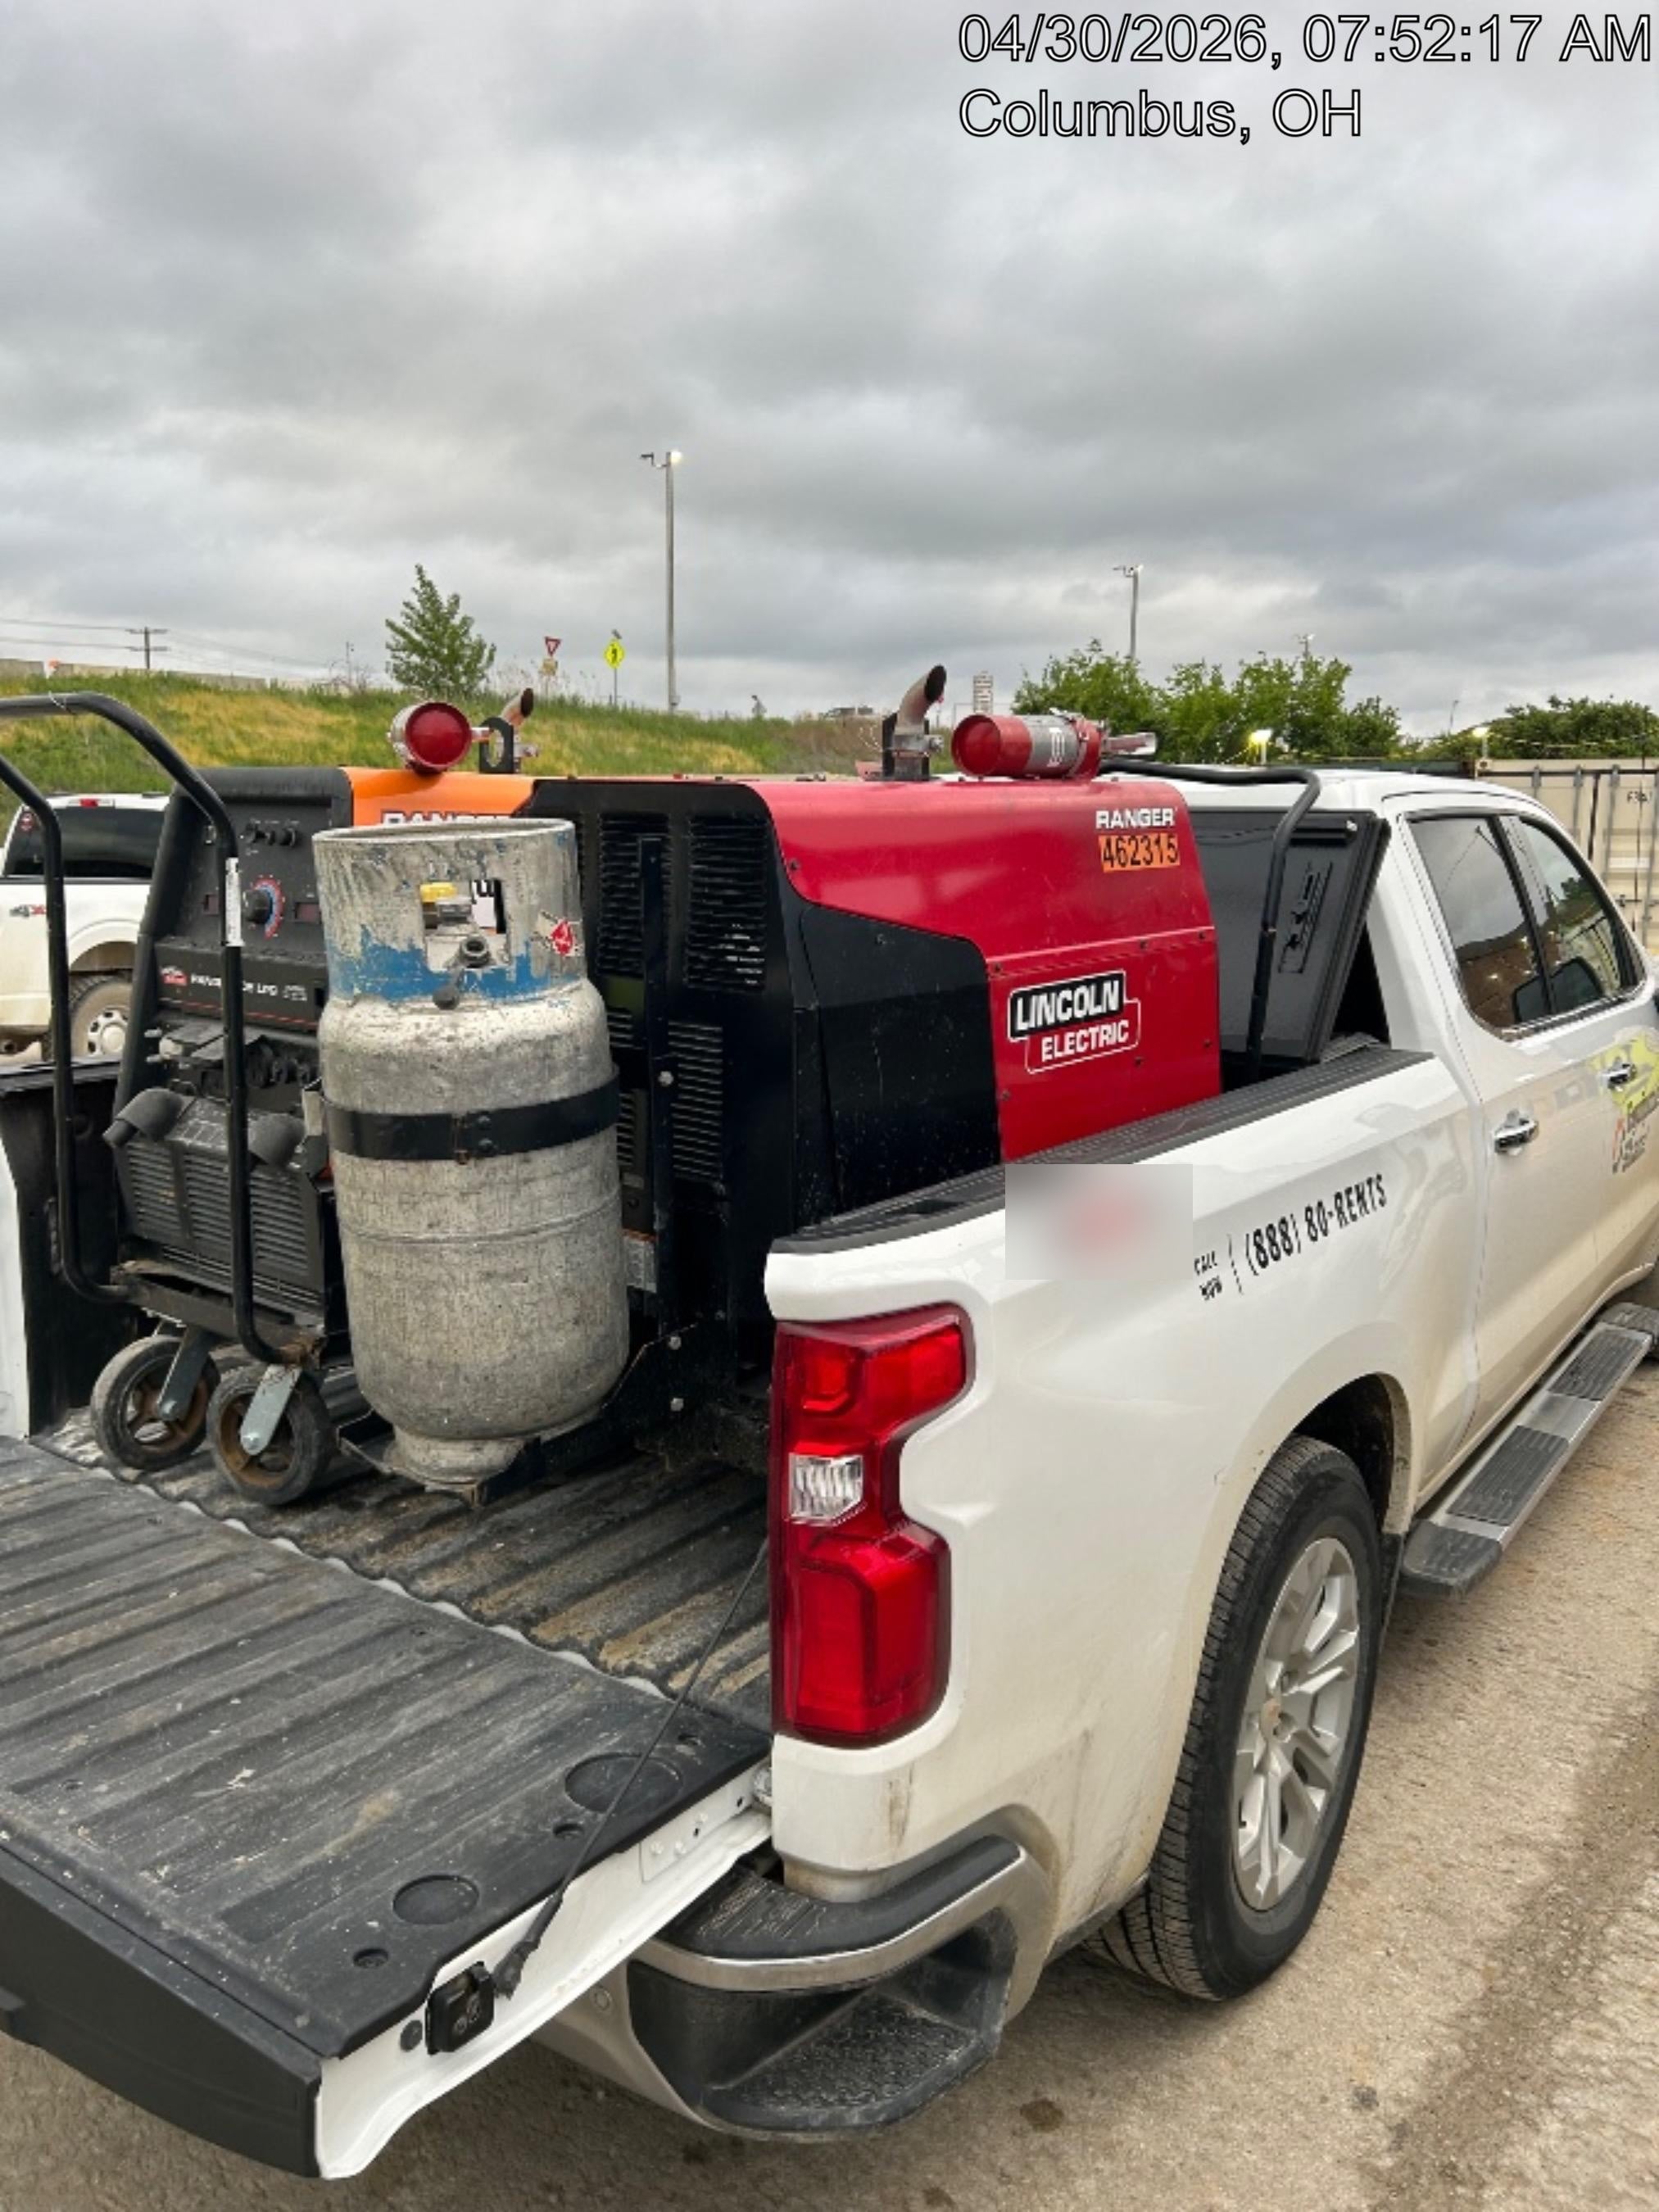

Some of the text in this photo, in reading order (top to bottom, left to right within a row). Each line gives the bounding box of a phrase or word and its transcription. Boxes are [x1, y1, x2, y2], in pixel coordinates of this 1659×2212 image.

[1096, 808, 1175, 829] RANGER
[1104, 833, 1178, 868] 462315
[1016, 981, 1119, 1031] LINCOLN
[1041, 1019, 1129, 1063] ELECTRIC
[1245, 1173, 1386, 1276] (888) 80-RENTS
